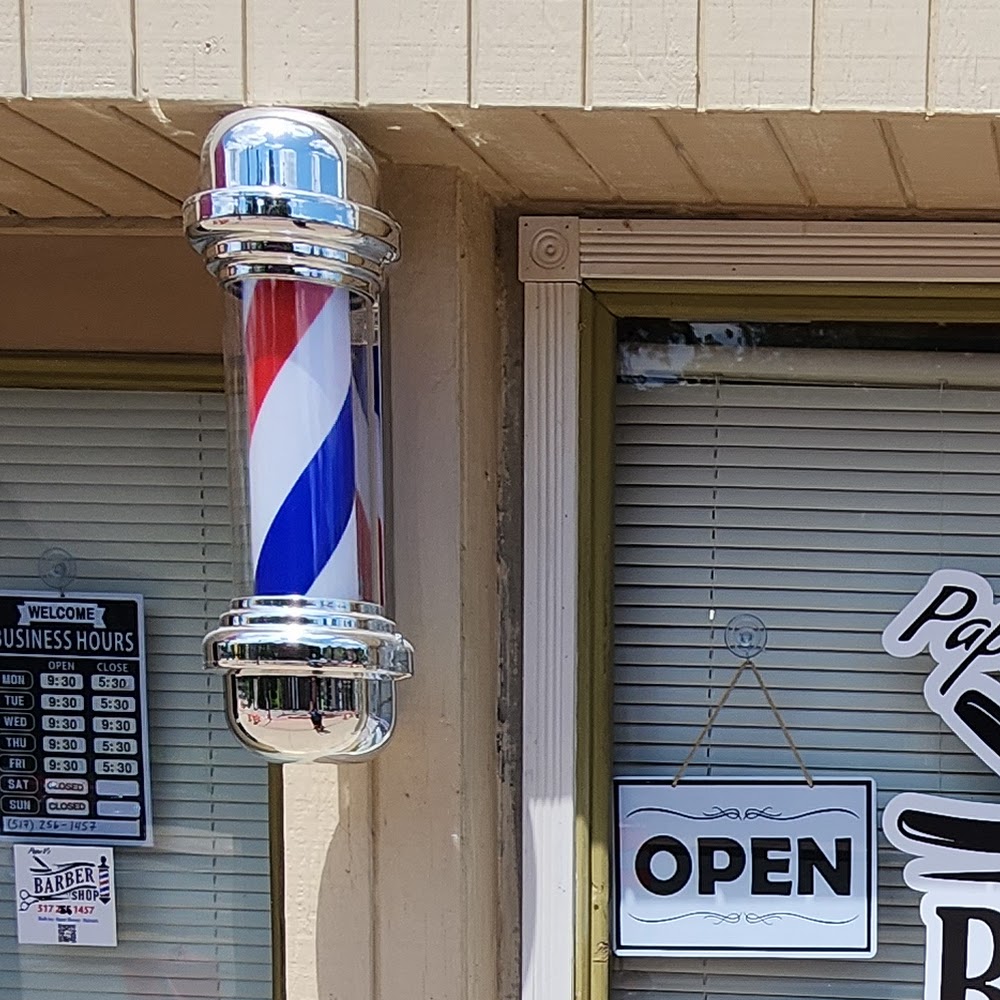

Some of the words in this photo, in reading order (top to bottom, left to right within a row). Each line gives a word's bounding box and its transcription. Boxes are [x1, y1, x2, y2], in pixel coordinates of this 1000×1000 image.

[28, 605, 96, 621] WELCOME
[0, 628, 72, 650] USINESS
[77, 630, 134, 652] HOURS
[48, 661, 75, 671] OPEN
[96, 662, 129, 673] CLOSE
[2, 674, 25, 685] MON
[47, 676, 76, 688] 9:30
[98, 677, 127, 688] 5:30
[4, 695, 25, 707] TUE
[48, 697, 77, 709] 9:30
[100, 698, 129, 710] 5:30
[3, 716, 28, 727] WED
[48, 718, 78, 730] 9:30
[5, 737, 27, 748] THU
[48, 738, 78, 751] 9:30
[102, 740, 131, 753] 5:30
[9, 757, 26, 767] FRI
[49, 759, 78, 772] 9:30
[102, 762, 132, 774] 5:30
[7, 778, 29, 790] SAT
[46, 781, 84, 792] CLOSED
[9, 799, 31, 811] SUN
[48, 800, 86, 811] CLOSED
[7, 820, 34, 831] (517)
[634, 834, 853, 897] OPEN
[34, 867, 95, 894] BARBER
[71, 889, 99, 902] SHOP
[37, 904, 53, 913] 517
[73, 905, 95, 914] 1457
